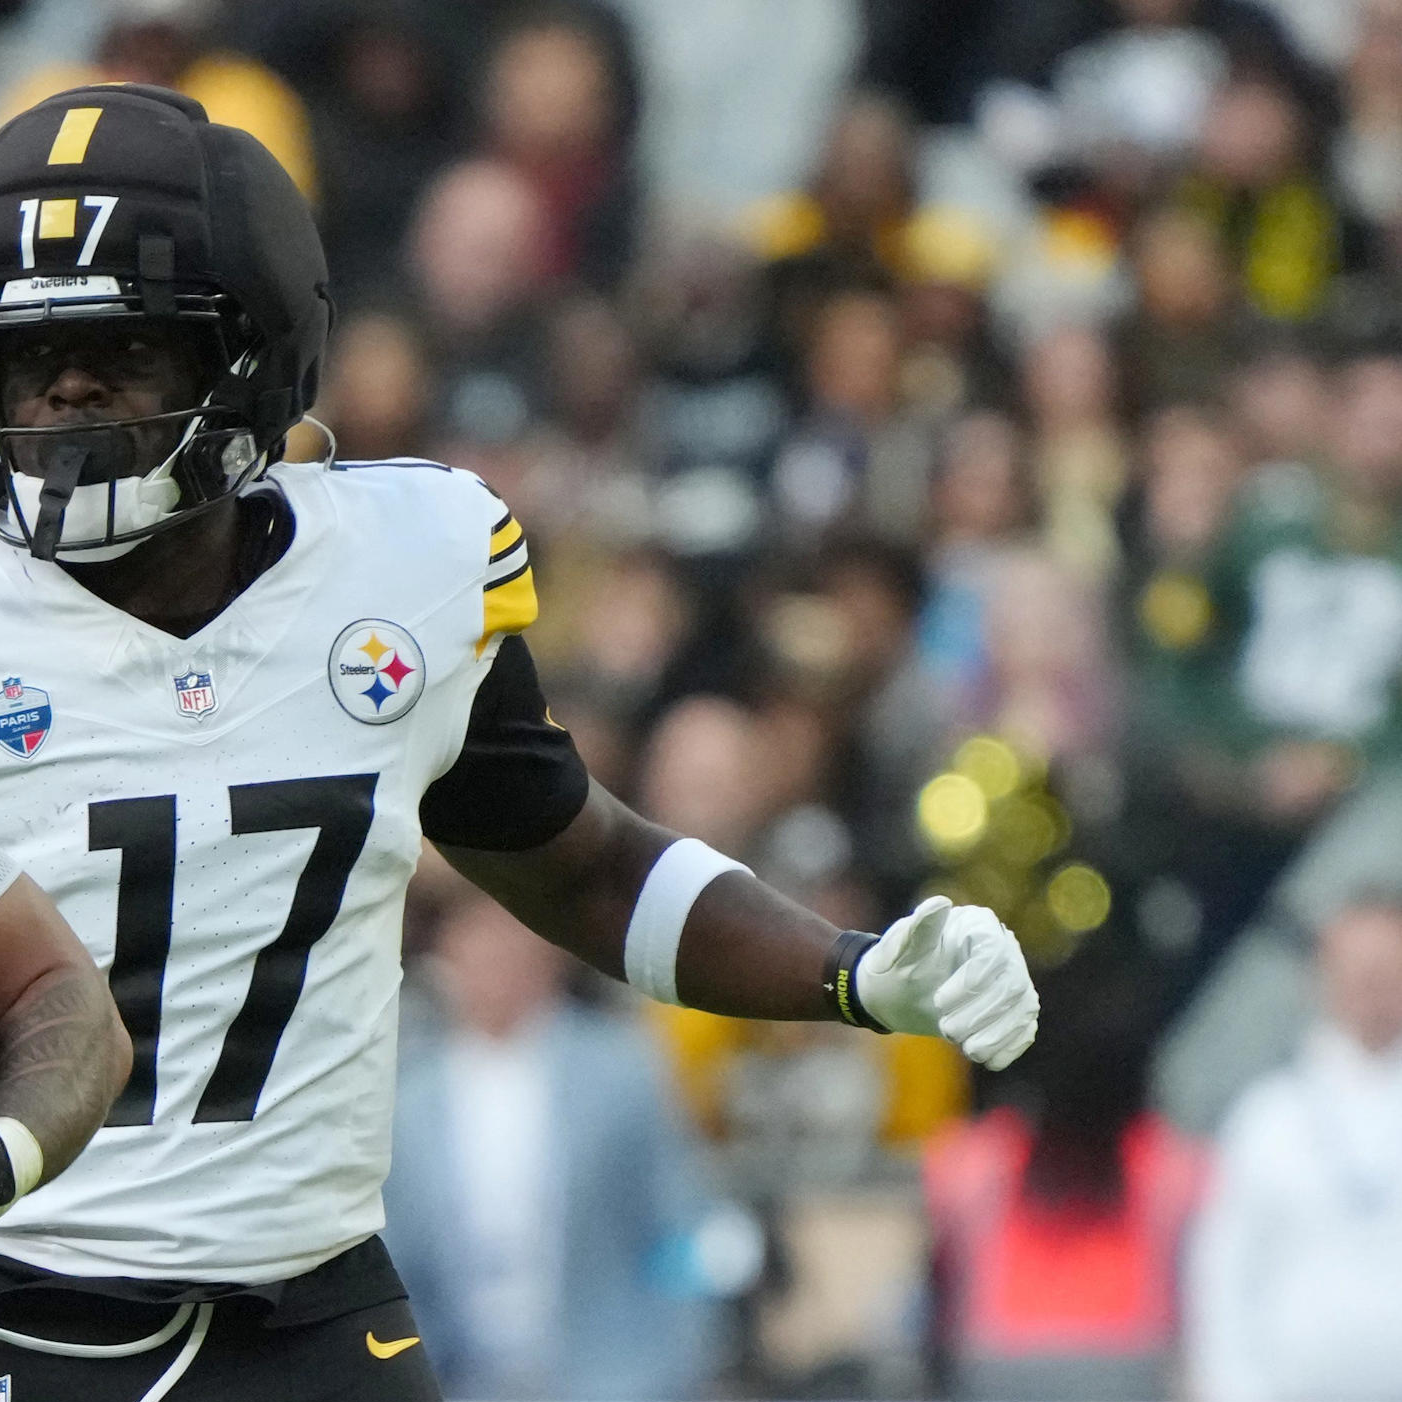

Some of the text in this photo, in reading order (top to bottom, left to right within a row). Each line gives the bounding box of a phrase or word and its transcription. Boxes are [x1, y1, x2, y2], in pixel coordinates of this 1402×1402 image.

[19, 194, 121, 270] 17
[339, 663, 376, 676] Steelers
[180, 688, 213, 711] NFL
[0, 711, 40, 729] PARIS
[86, 771, 381, 1127] 17
